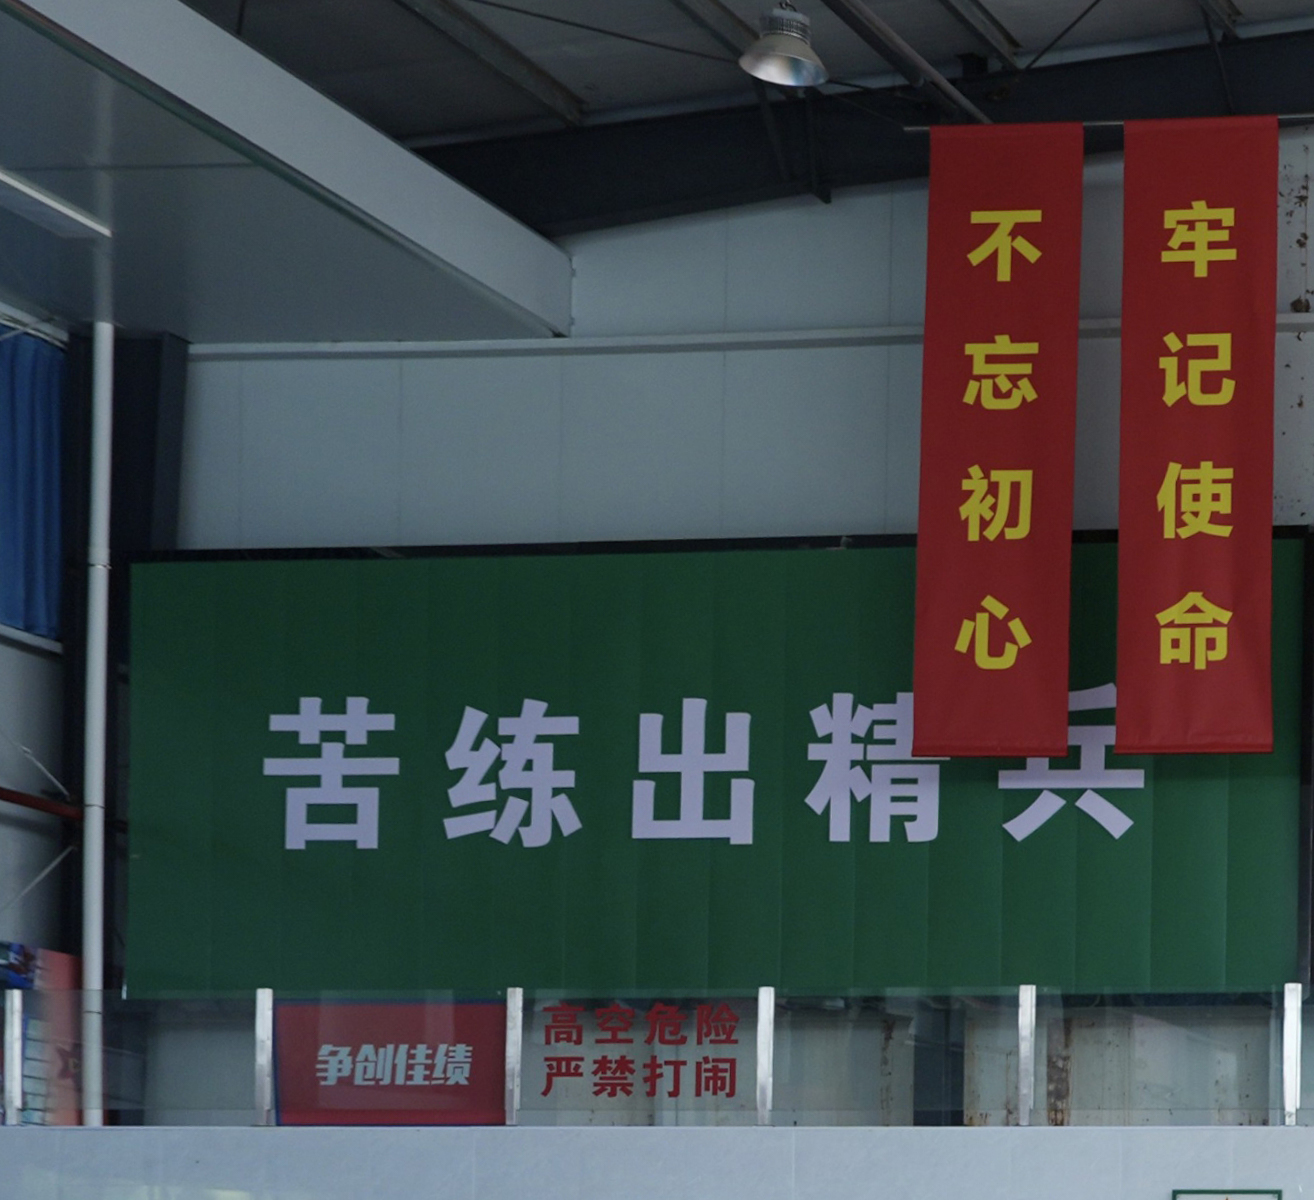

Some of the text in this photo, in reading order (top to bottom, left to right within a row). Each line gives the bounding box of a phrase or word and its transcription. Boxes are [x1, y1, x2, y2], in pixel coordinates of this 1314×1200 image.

[953, 208, 1043, 672] 不忘初心
[1155, 199, 1238, 671] 牢记使命
[262, 682, 1145, 850] 苦练出精兵
[315, 1043, 473, 1086] 争创佳绩
[540, 1054, 737, 1099] 严禁打闹
[541, 1001, 739, 1046] 高空危险
